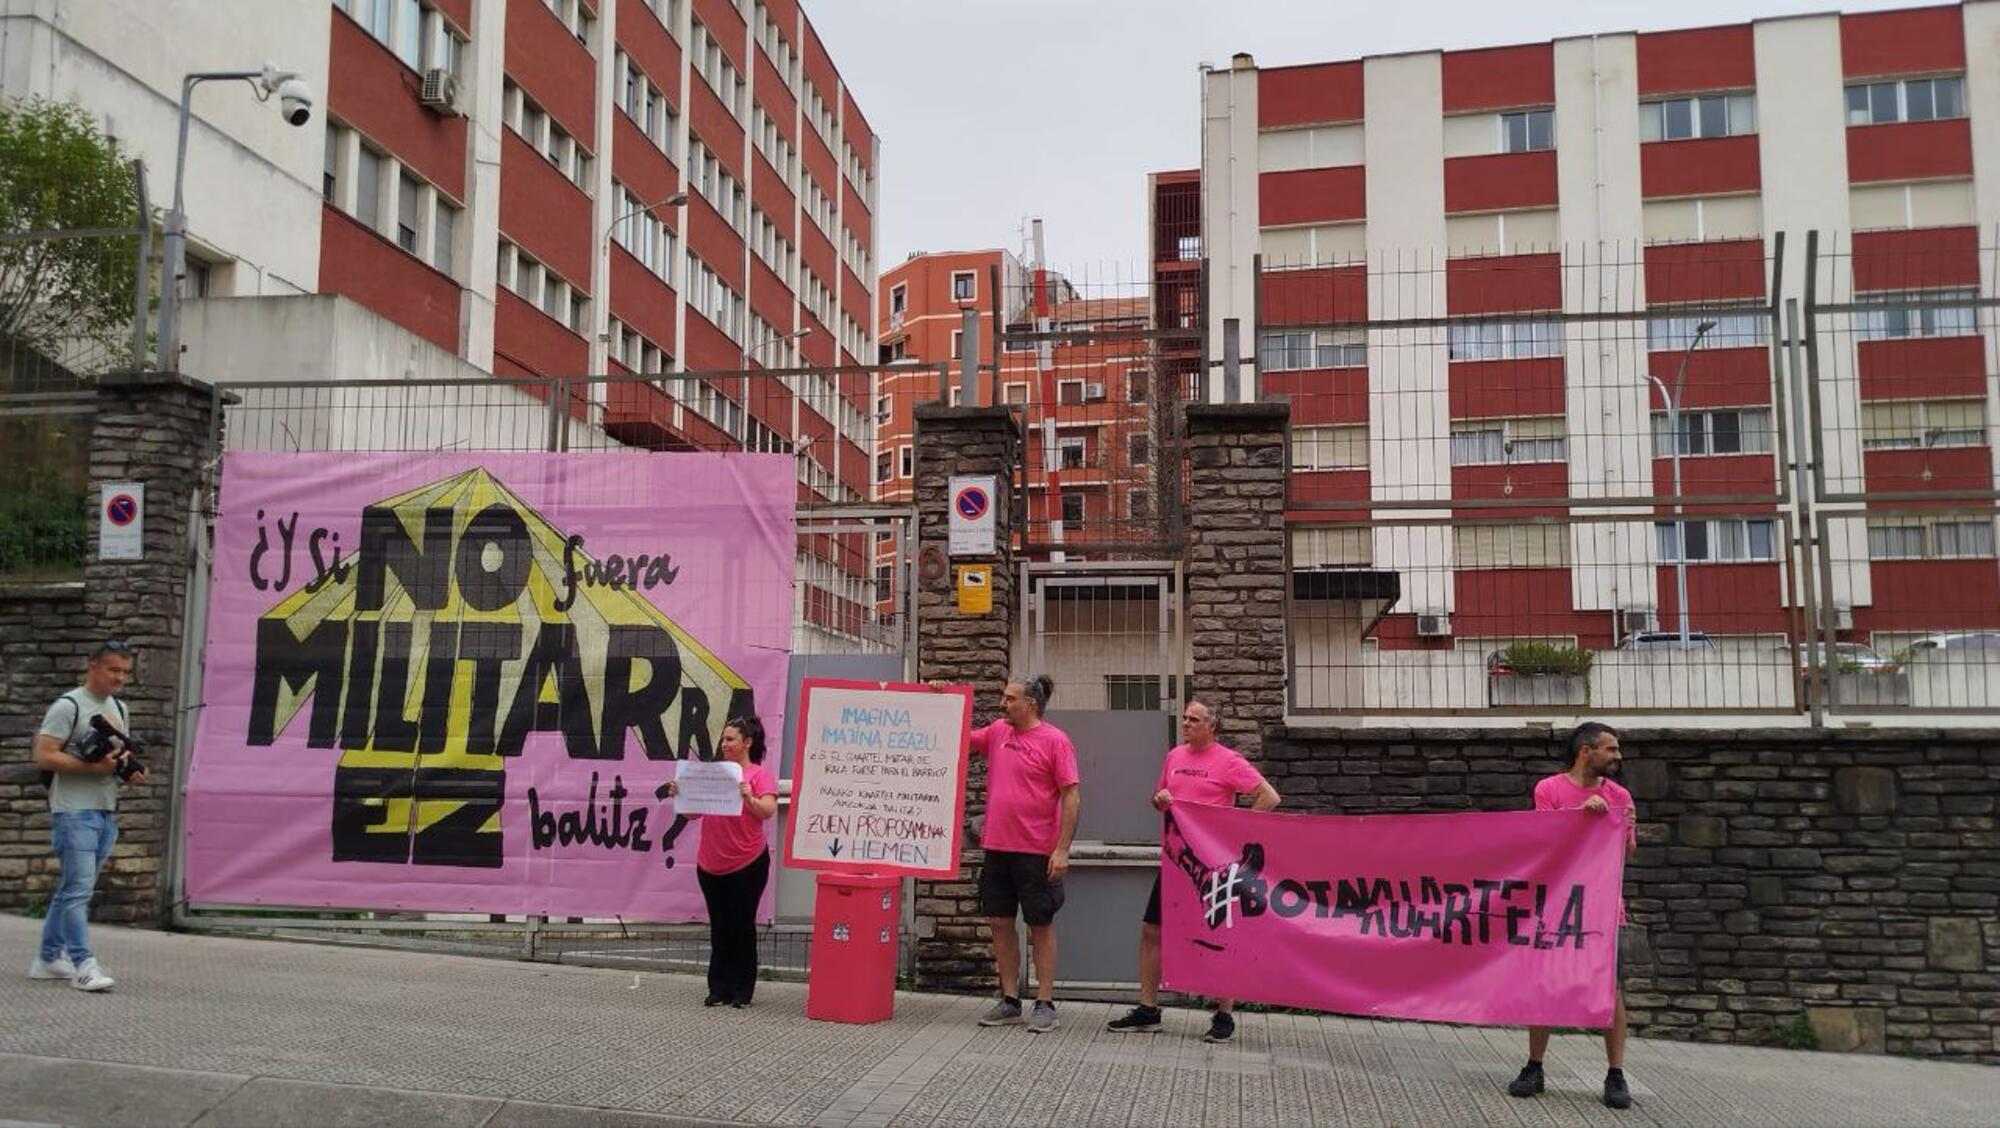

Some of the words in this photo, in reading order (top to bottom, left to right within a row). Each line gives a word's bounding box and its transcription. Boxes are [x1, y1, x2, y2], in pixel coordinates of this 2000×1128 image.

[249, 508, 299, 592] ¿Y
[356, 502, 534, 612] NO
[553, 534, 680, 612] fuera
[841, 707, 911, 727] IMAGINA
[822, 726, 882, 748] IMAJINA
[887, 730, 937, 752] EZAZU
[332, 765, 505, 868] EZ
[807, 813, 850, 837] ZUEN
[851, 839, 929, 865] HEMEN
